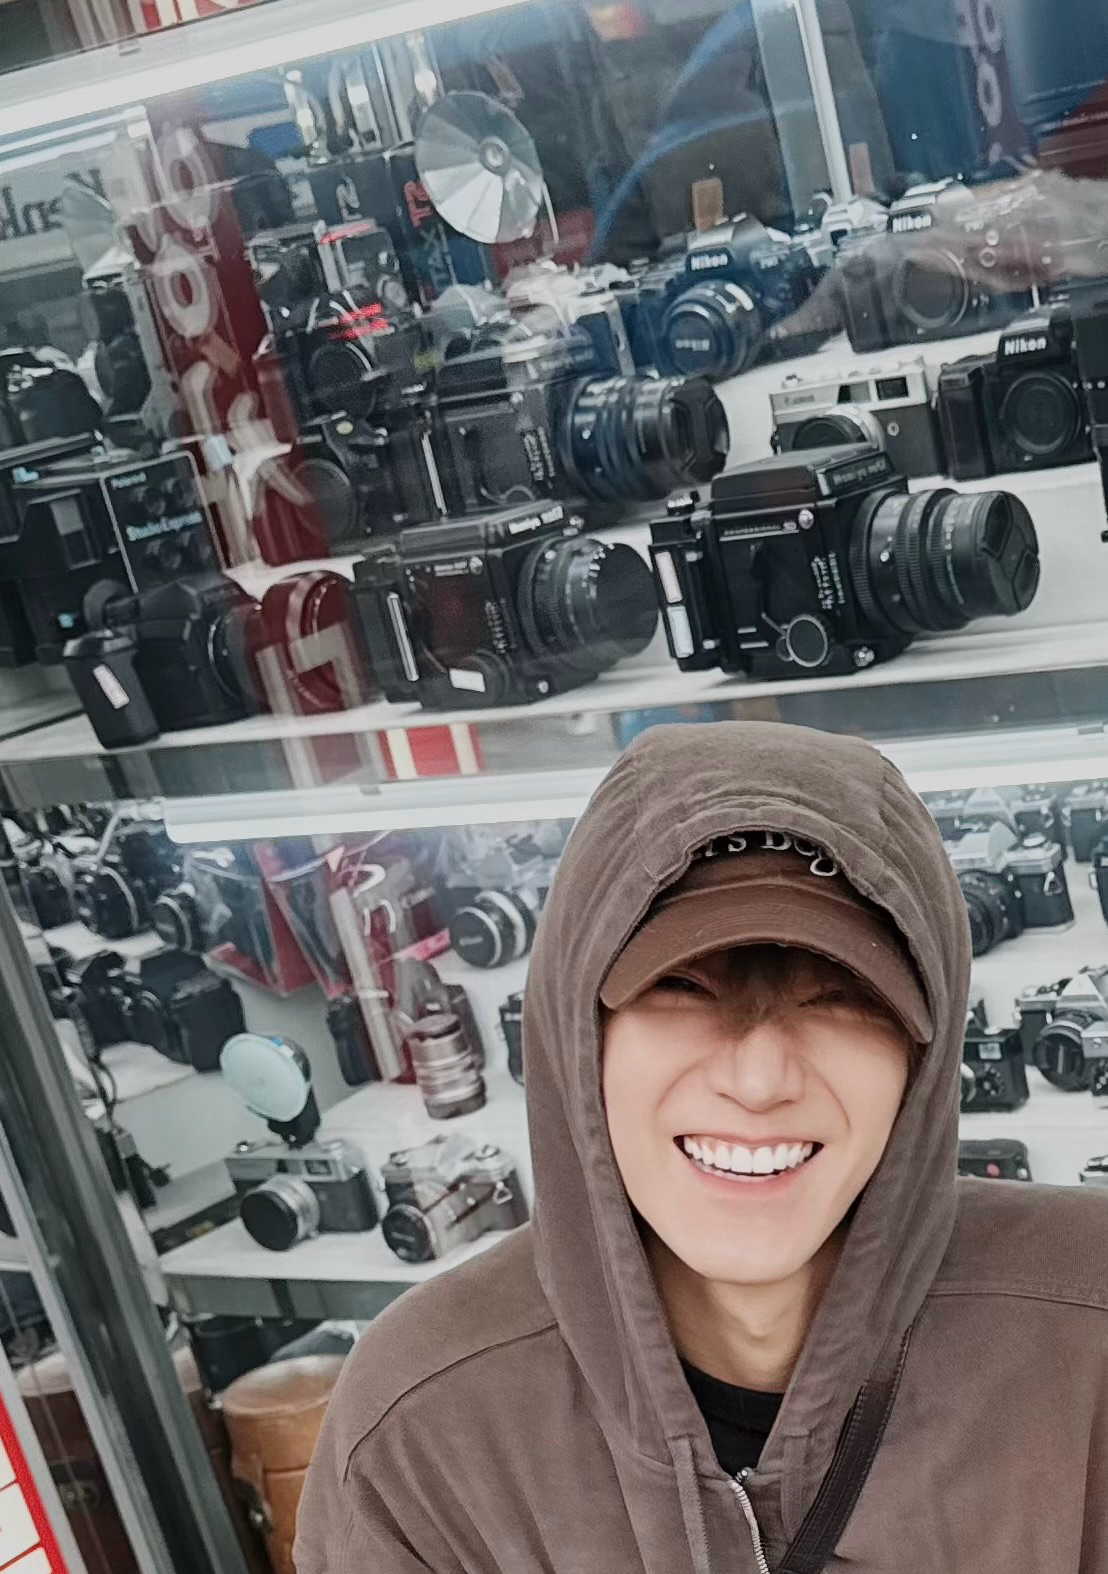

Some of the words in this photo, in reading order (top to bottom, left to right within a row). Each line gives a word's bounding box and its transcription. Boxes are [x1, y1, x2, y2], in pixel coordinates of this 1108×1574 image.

[892, 214, 932, 233] Nikon
[690, 253, 729, 271] Nikon
[1004, 337, 1047, 356] Nikon
